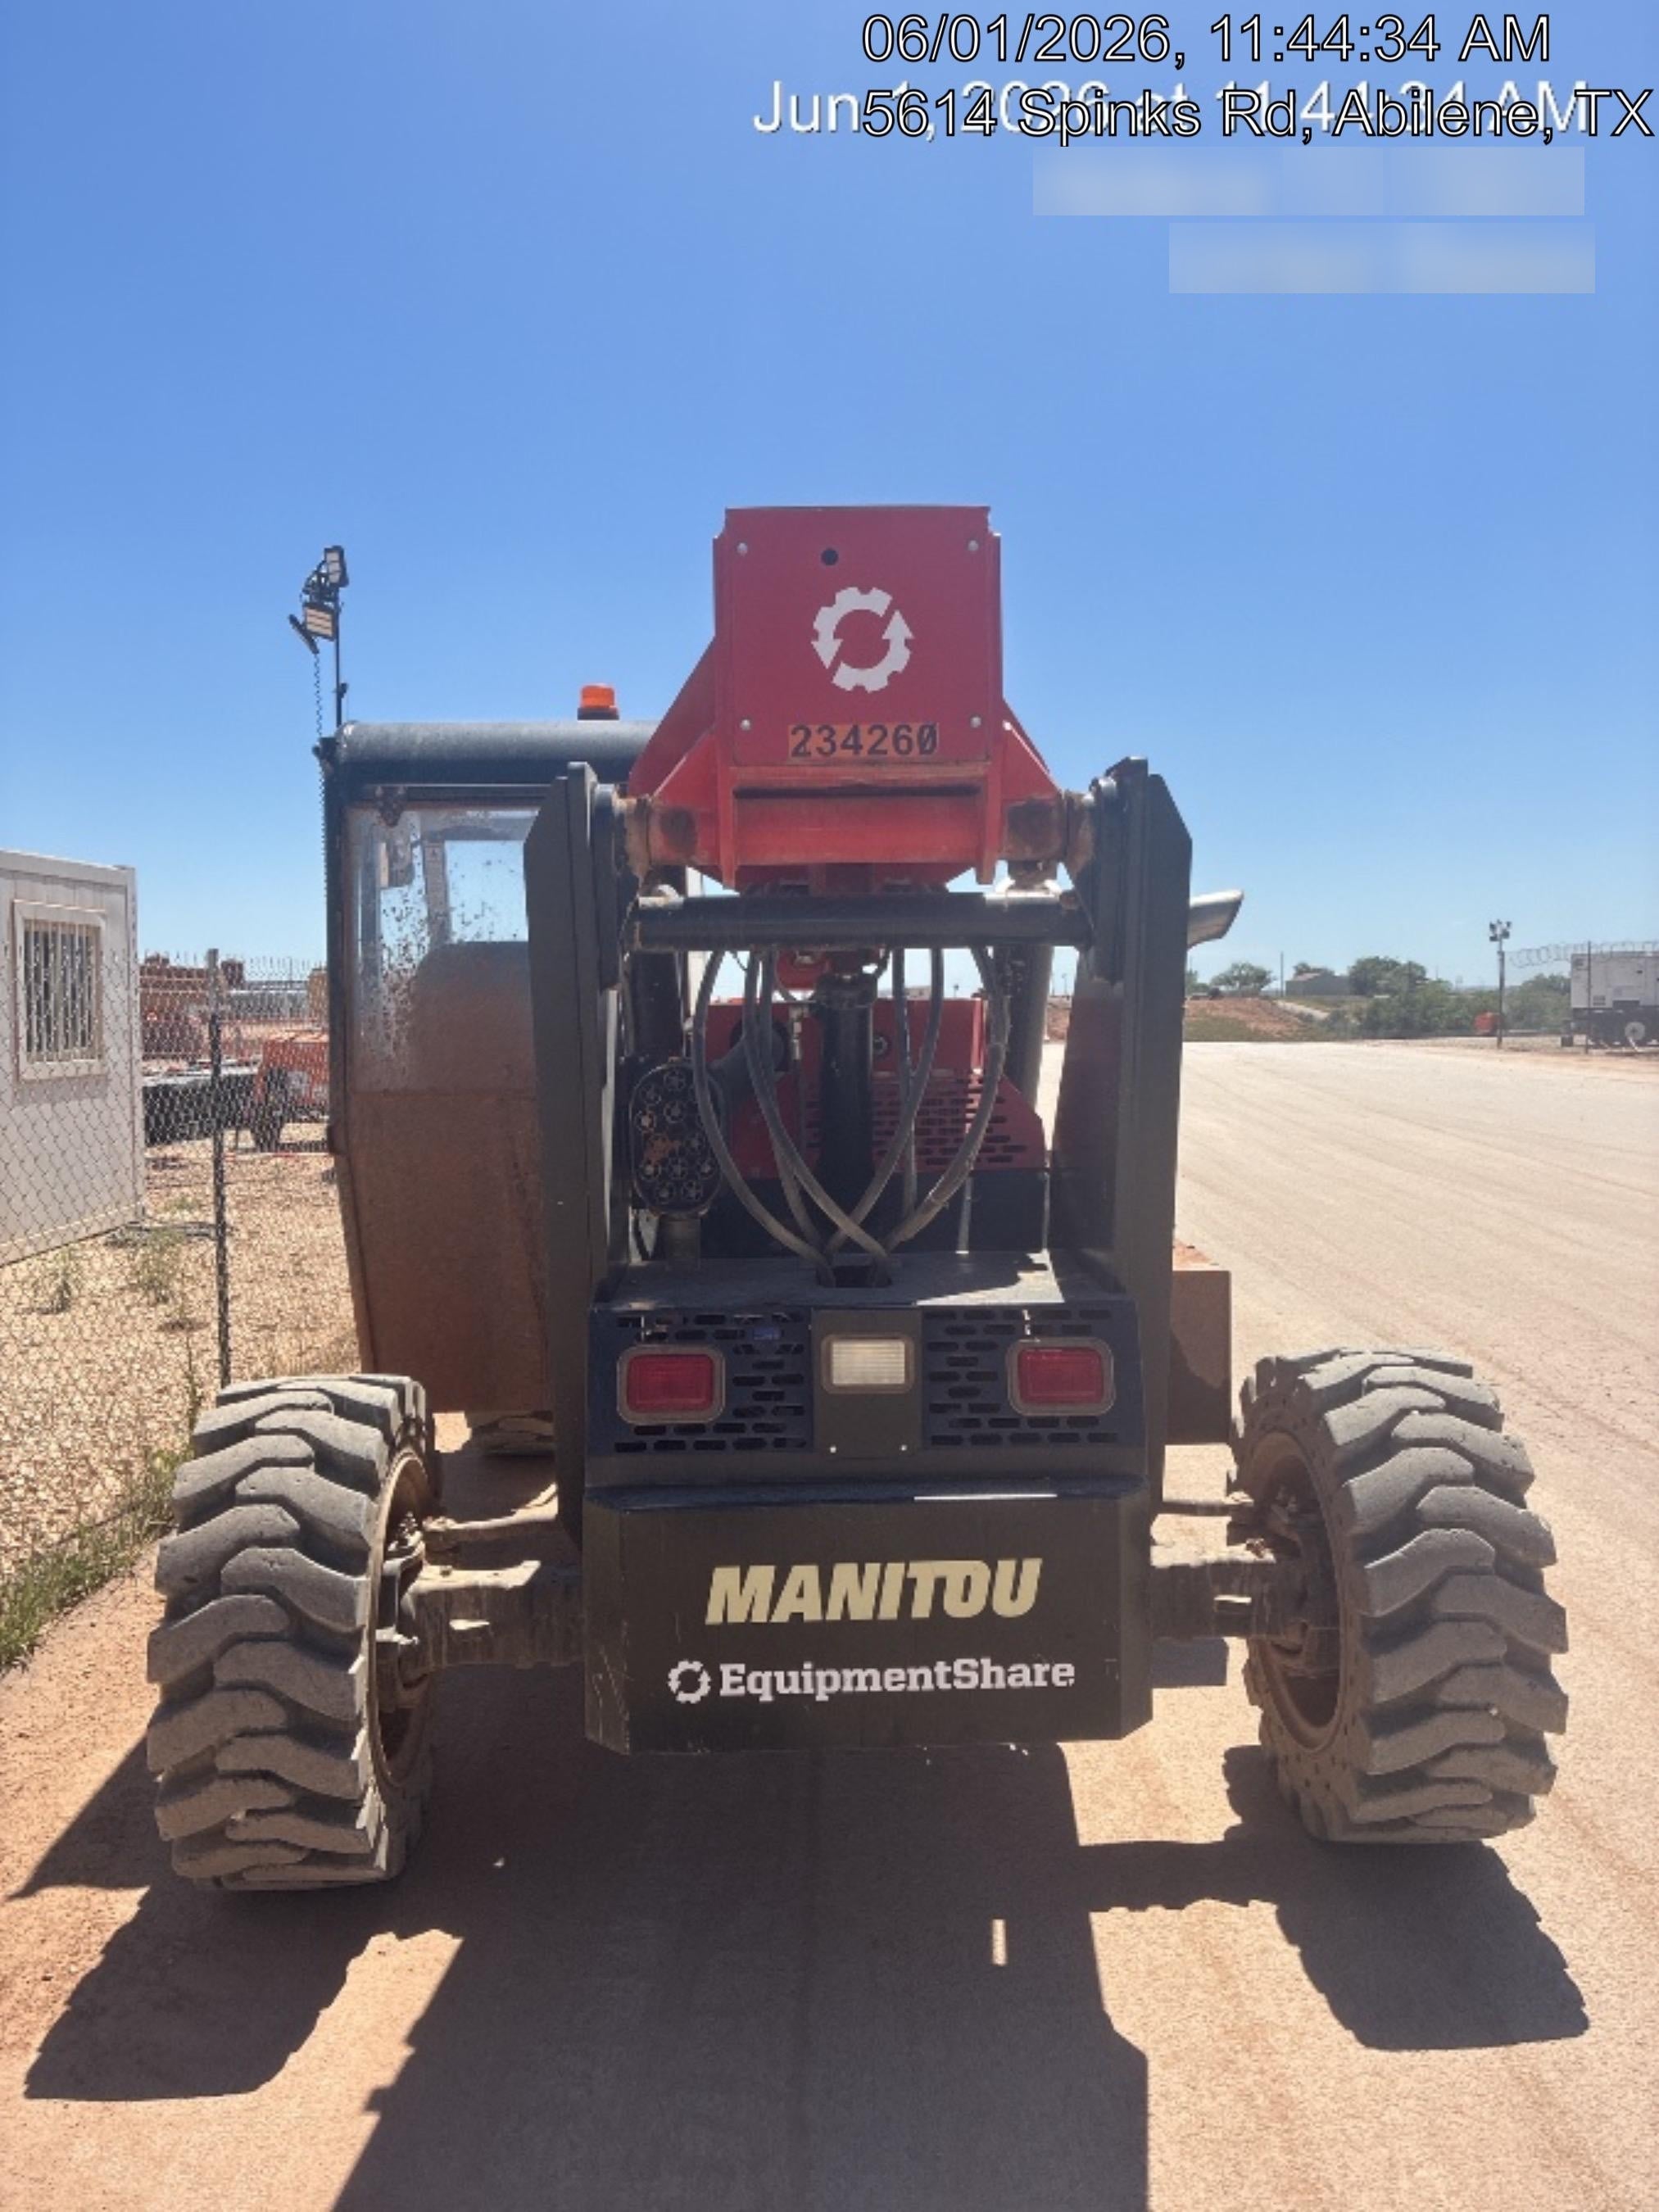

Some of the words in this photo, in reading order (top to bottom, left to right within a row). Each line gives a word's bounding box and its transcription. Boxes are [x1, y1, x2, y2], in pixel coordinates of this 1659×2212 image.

[790, 723, 938, 759] 234260
[705, 1557, 1043, 1625] MANITOU
[719, 1657, 1076, 1702] EquipmentShare
